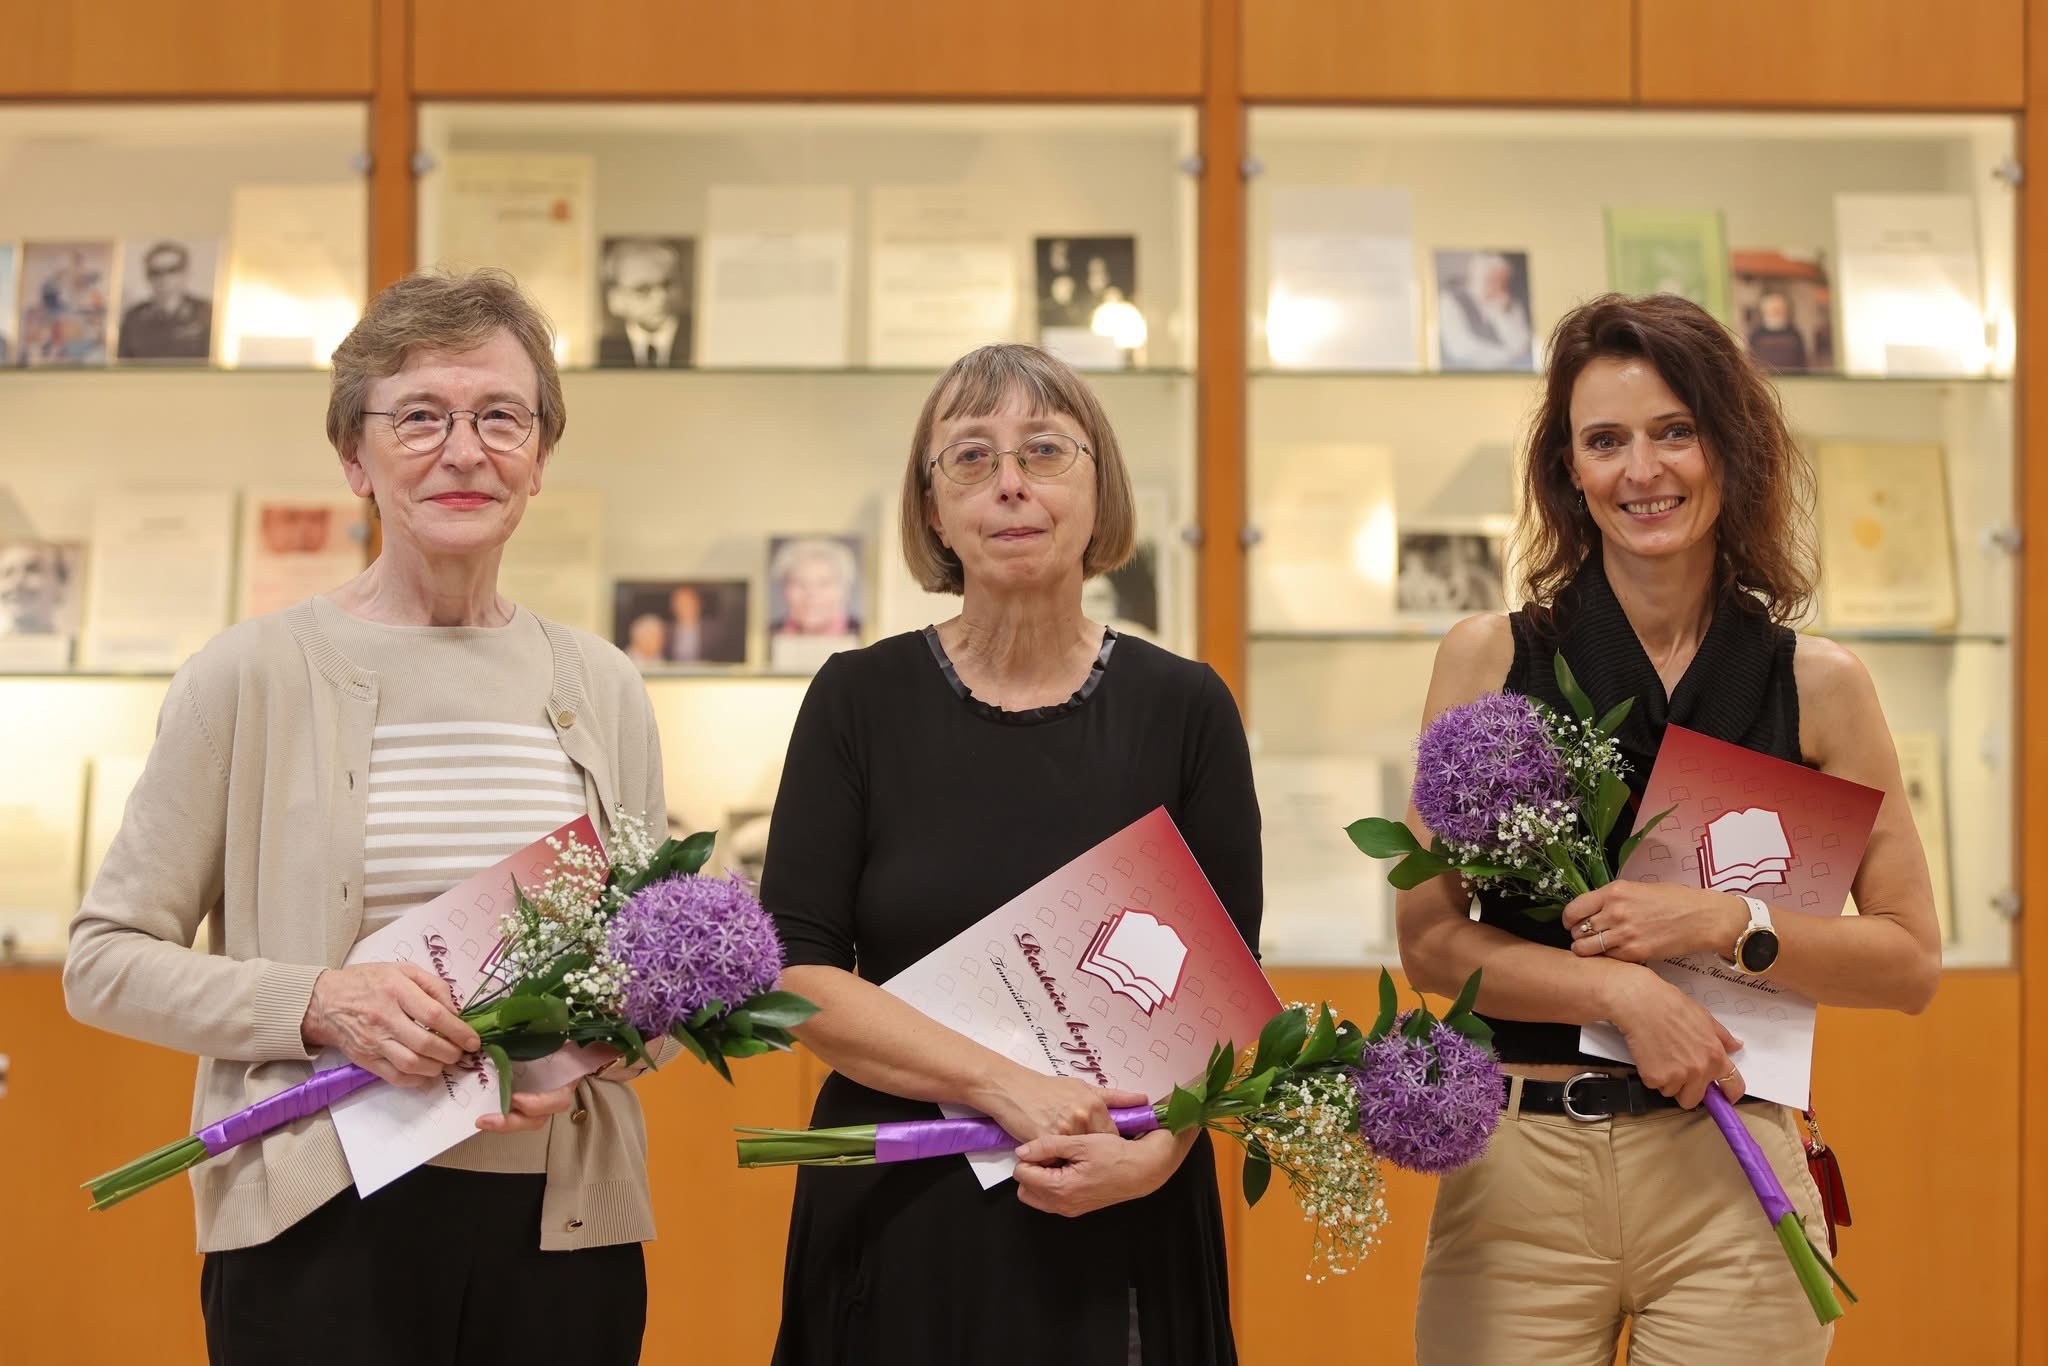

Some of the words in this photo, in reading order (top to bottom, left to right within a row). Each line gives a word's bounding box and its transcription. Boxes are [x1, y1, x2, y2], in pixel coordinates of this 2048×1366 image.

[1702, 966, 1746, 986] Mirnske
[1747, 979, 1780, 994] doline
[1014, 933, 1070, 1017] Rastoča
[1060, 1022, 1108, 1088] knjiga
[1023, 1011, 1033, 1022] in
